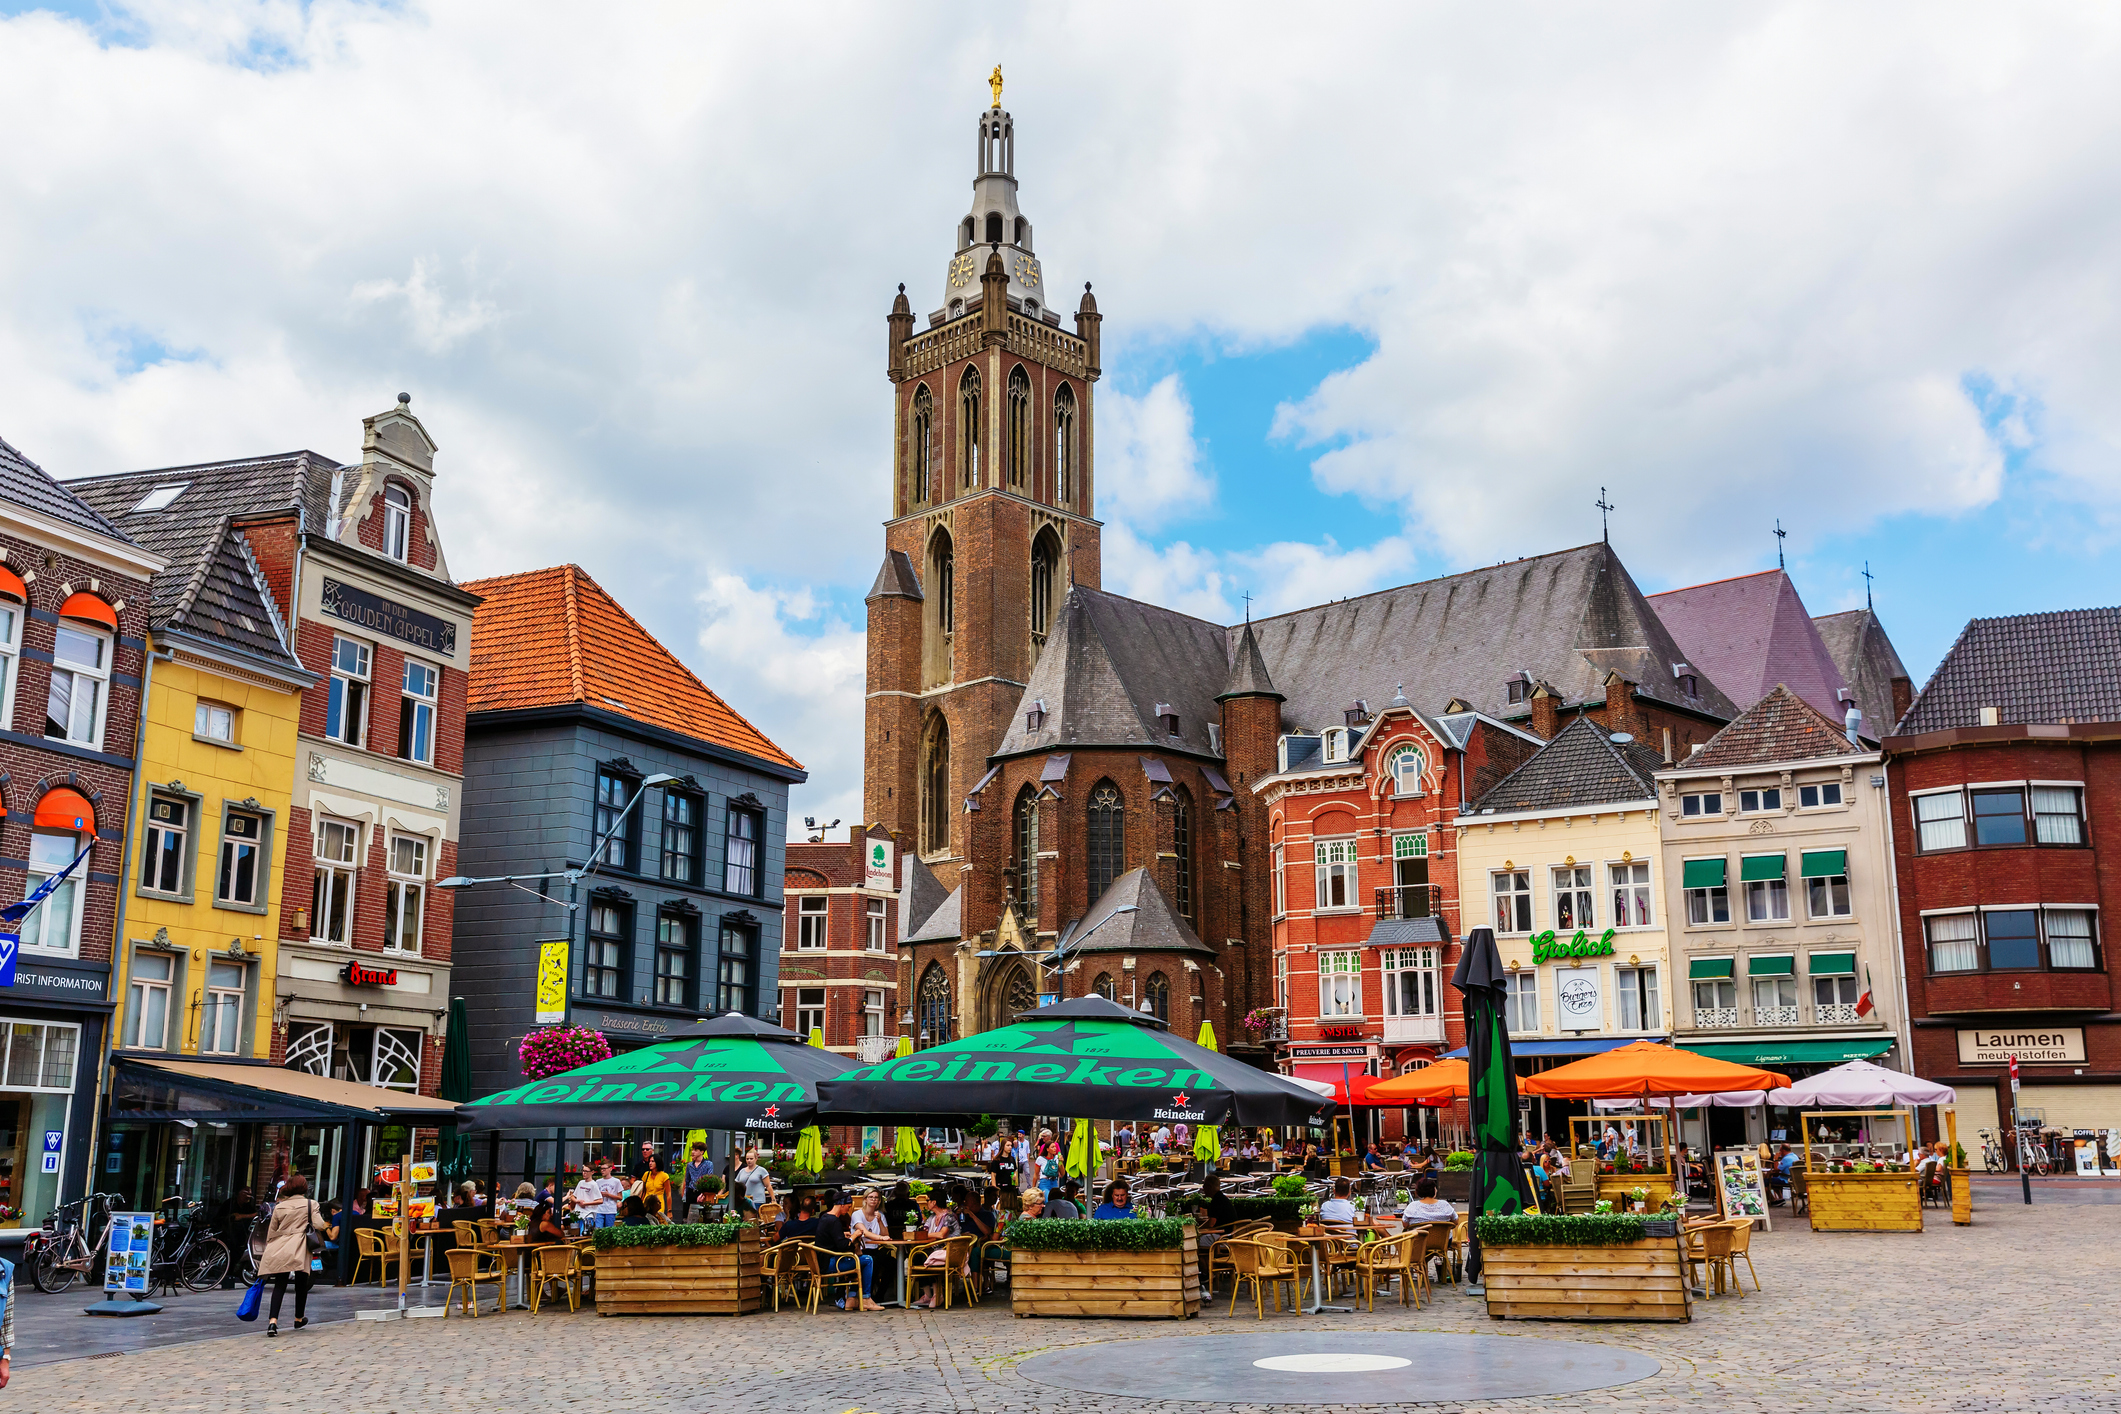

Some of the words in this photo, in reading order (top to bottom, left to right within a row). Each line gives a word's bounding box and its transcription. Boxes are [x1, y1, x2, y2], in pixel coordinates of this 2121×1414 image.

[382, 601, 390, 613] IN
[392, 604, 408, 619] DEN
[341, 601, 393, 633] GOUDEN
[394, 619, 437, 649] APPEL
[1529, 928, 1615, 965] Grolsch
[13, 973, 37, 985] URIST
[38, 975, 102, 990] INFORMATION
[350, 961, 397, 985] Brand
[1560, 990, 1597, 1002] Burgers
[601, 1015, 640, 1030] Brasserie
[642, 1020, 668, 1032] Entrée
[1319, 1026, 1358, 1037] AMSTEL
[1975, 1031, 2065, 1047] Laumen
[1977, 1050, 2067, 1060] meubelstoffen
[829, 1054, 1217, 1090] Heineken
[466, 1074, 807, 1106] Heineken
[1153, 1108, 1205, 1120] Heineken
[744, 1118, 793, 1129] Heineken
[1000, 1162, 1015, 1170] FILA
